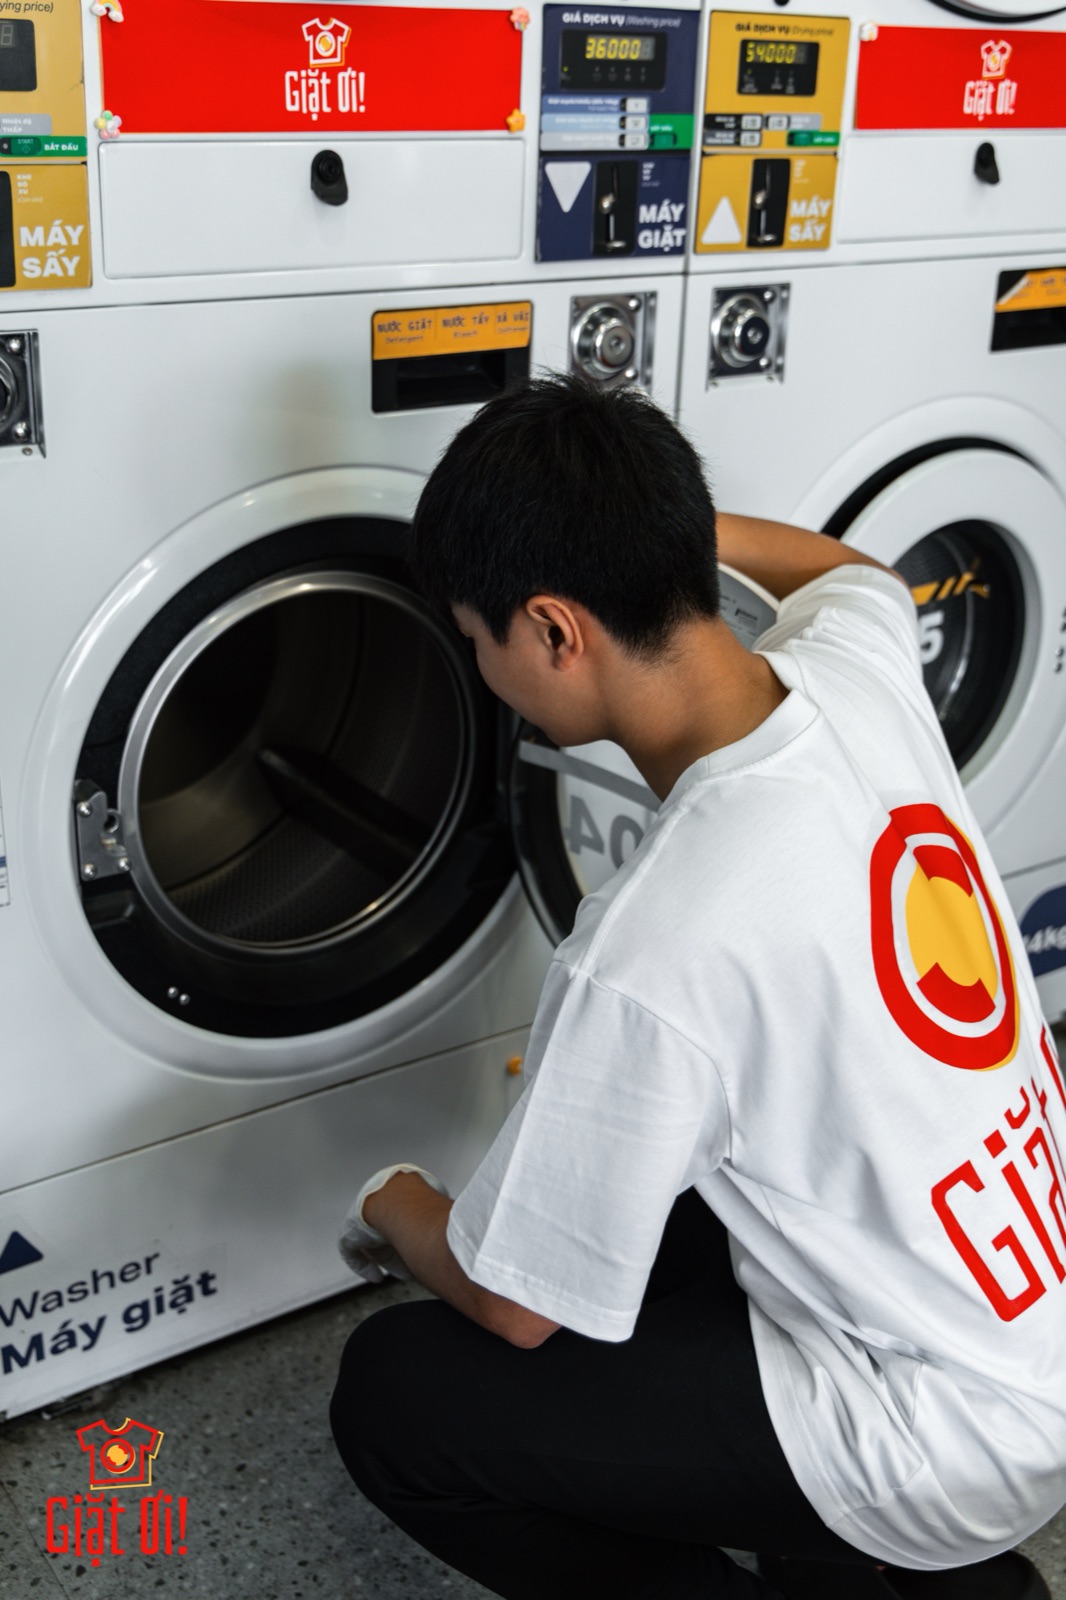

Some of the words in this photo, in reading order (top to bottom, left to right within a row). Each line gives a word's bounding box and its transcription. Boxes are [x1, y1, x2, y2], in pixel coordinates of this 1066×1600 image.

[24, 2, 54, 13] price)
[562, 11, 581, 24] GIÁ
[583, 13, 608, 26] DỊCH
[610, 14, 625, 27] VỤ
[585, 37, 641, 59] 36000
[746, 42, 797, 64] 54000
[285, 68, 332, 121] Giặt
[639, 199, 685, 223] MÁY
[790, 194, 831, 218] MÁY
[20, 219, 85, 247] MÁY
[638, 225, 687, 252] GIẶT
[22, 249, 81, 279] SẤY
[0, 1253, 160, 1328] Washer
[1, 1314, 107, 1375] Máy
[122, 1271, 217, 1334] giặt
